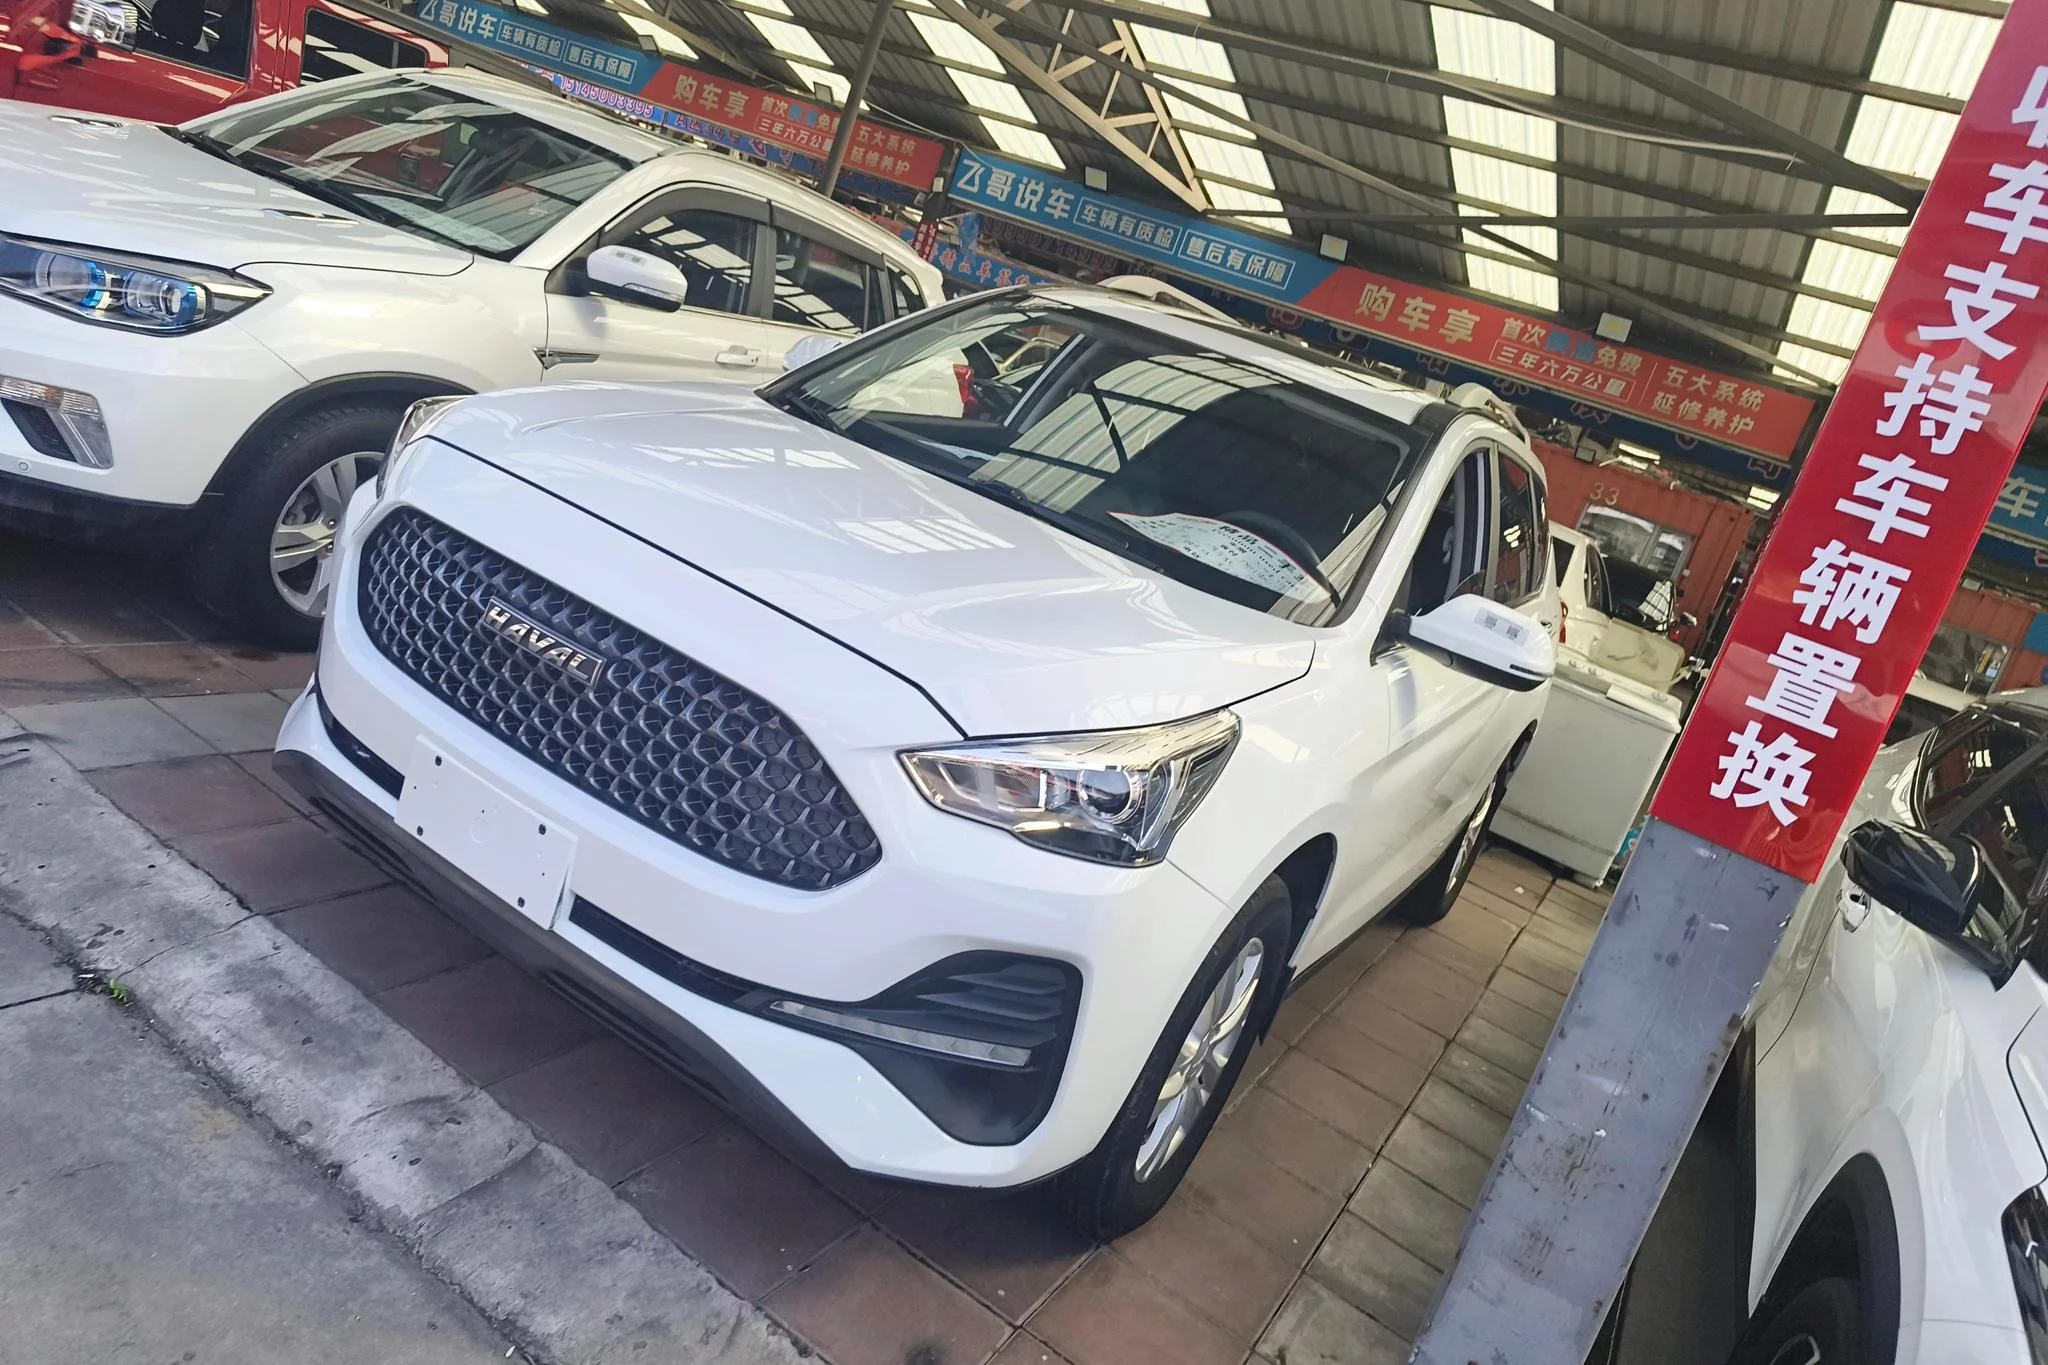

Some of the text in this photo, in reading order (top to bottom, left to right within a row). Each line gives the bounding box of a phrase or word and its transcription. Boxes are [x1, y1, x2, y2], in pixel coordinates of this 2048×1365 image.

[501, 24, 562, 58] 车辆有质检
[567, 44, 633, 79] 售后有保障
[674, 74, 749, 118] 购车享
[850, 145, 910, 175] 延修养护
[856, 125, 917, 157] 五大系统
[956, 158, 1075, 219] 飞哥说车
[1080, 204, 1176, 249] 车辆有质检
[1185, 237, 1288, 285] 售后有保障
[1354, 282, 1481, 344] 购车享
[1496, 346, 1627, 397] 三年六万公里
[1662, 365, 1766, 412] 五大系统
[1651, 390, 1755, 435] 延修养护
[1589, 482, 1620, 506] 33
[1996, 477, 2047, 519] 车
[484, 606, 589, 680] HAVAL
